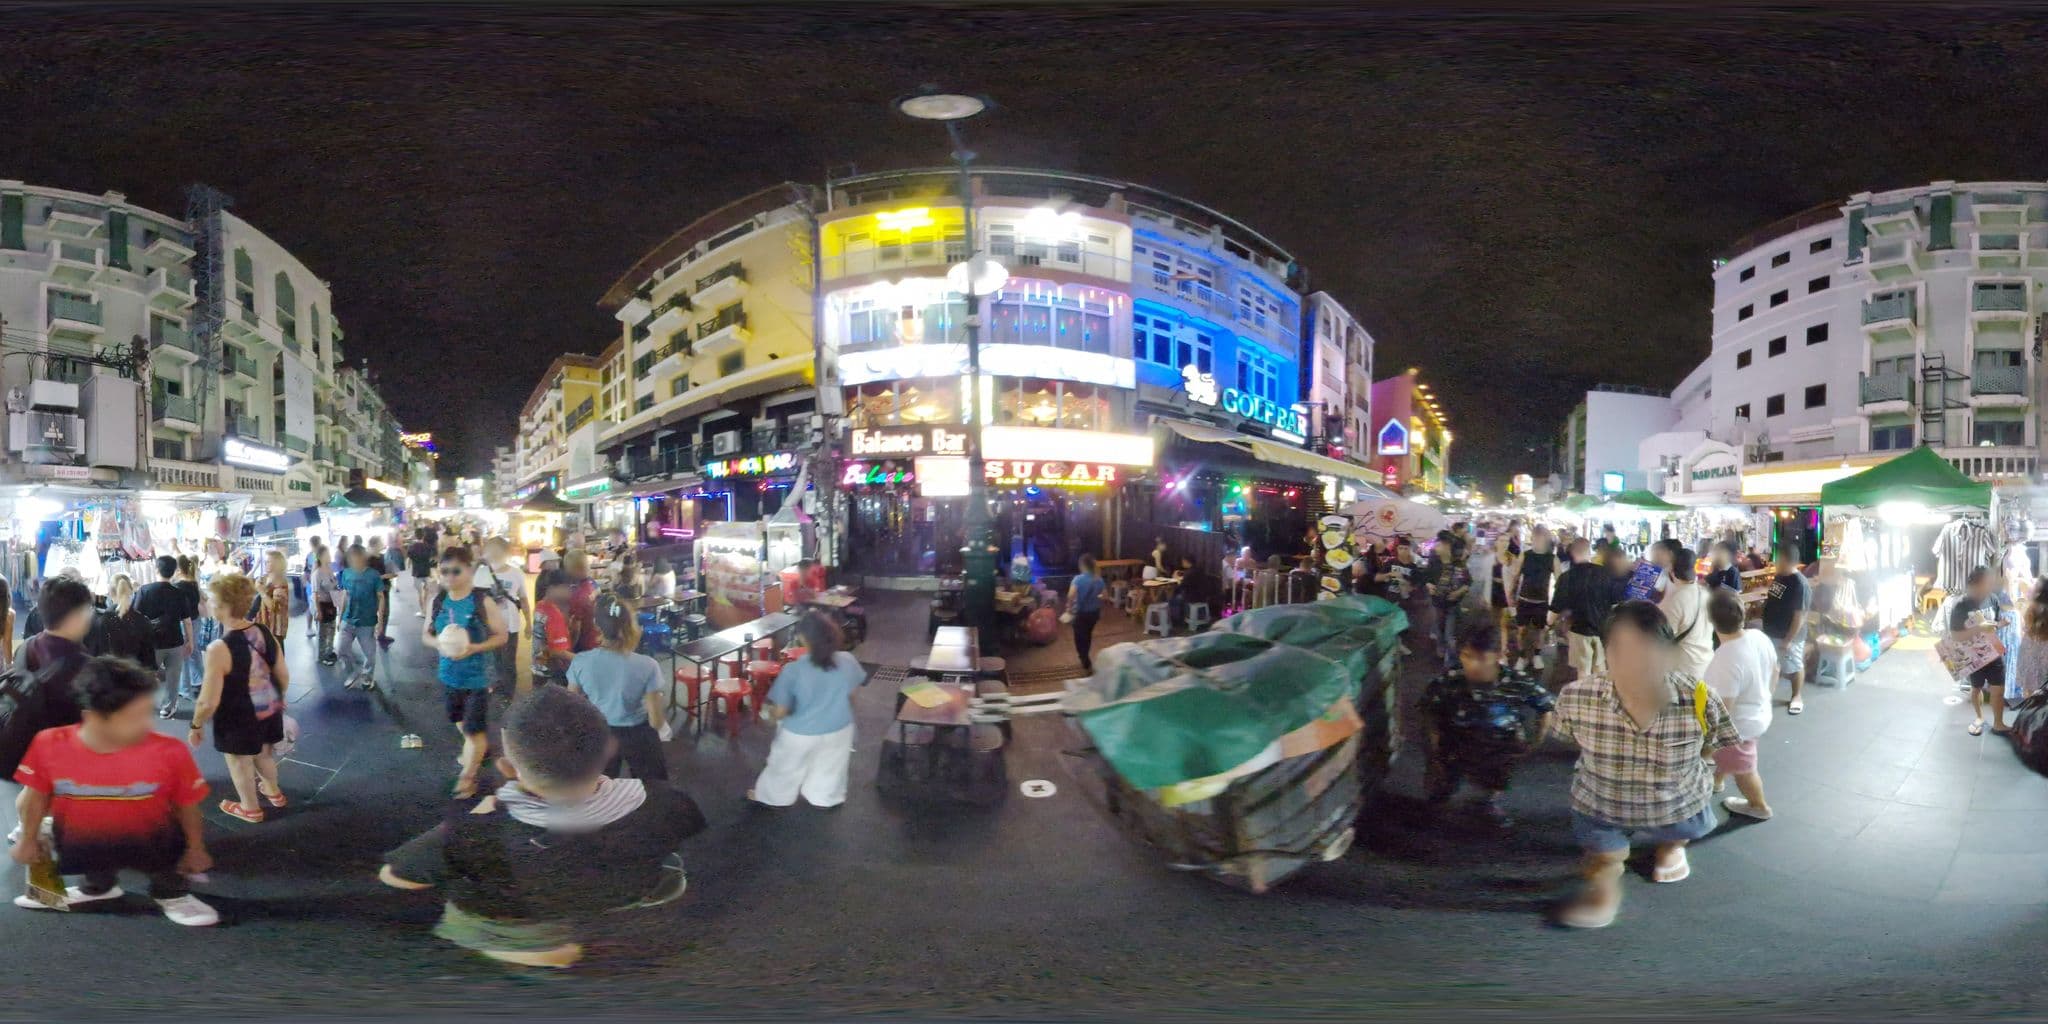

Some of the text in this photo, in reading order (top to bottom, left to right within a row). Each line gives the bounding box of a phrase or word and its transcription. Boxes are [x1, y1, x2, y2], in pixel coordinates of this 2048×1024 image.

[1222, 387, 1276, 424] GOLF
[1276, 406, 1308, 437] BAR
[852, 428, 966, 454] Balance Bar
